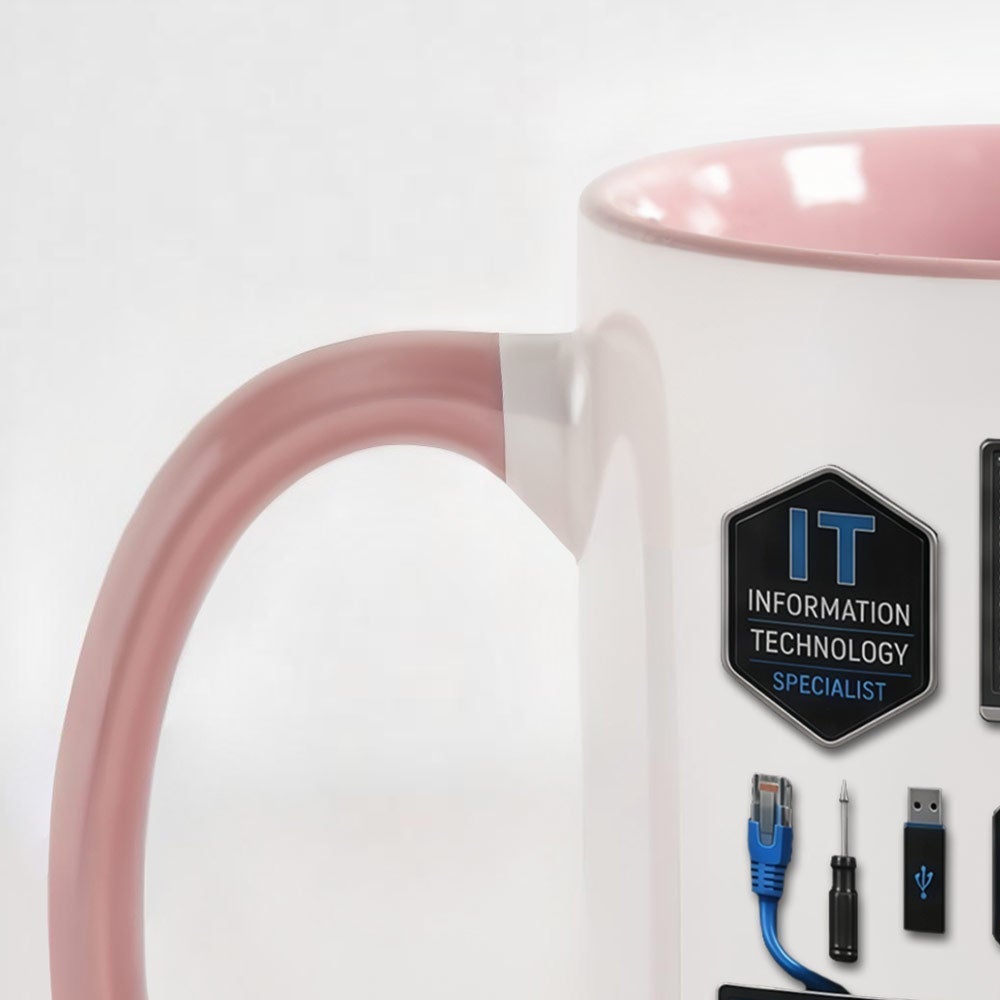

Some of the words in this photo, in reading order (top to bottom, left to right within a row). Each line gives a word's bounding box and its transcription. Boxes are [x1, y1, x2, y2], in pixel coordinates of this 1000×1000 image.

[789, 507, 875, 586] IT
[748, 588, 910, 627] INFORMATION
[750, 629, 909, 666] TECHNOLOGY
[772, 671, 887, 701] SPECIALIST
